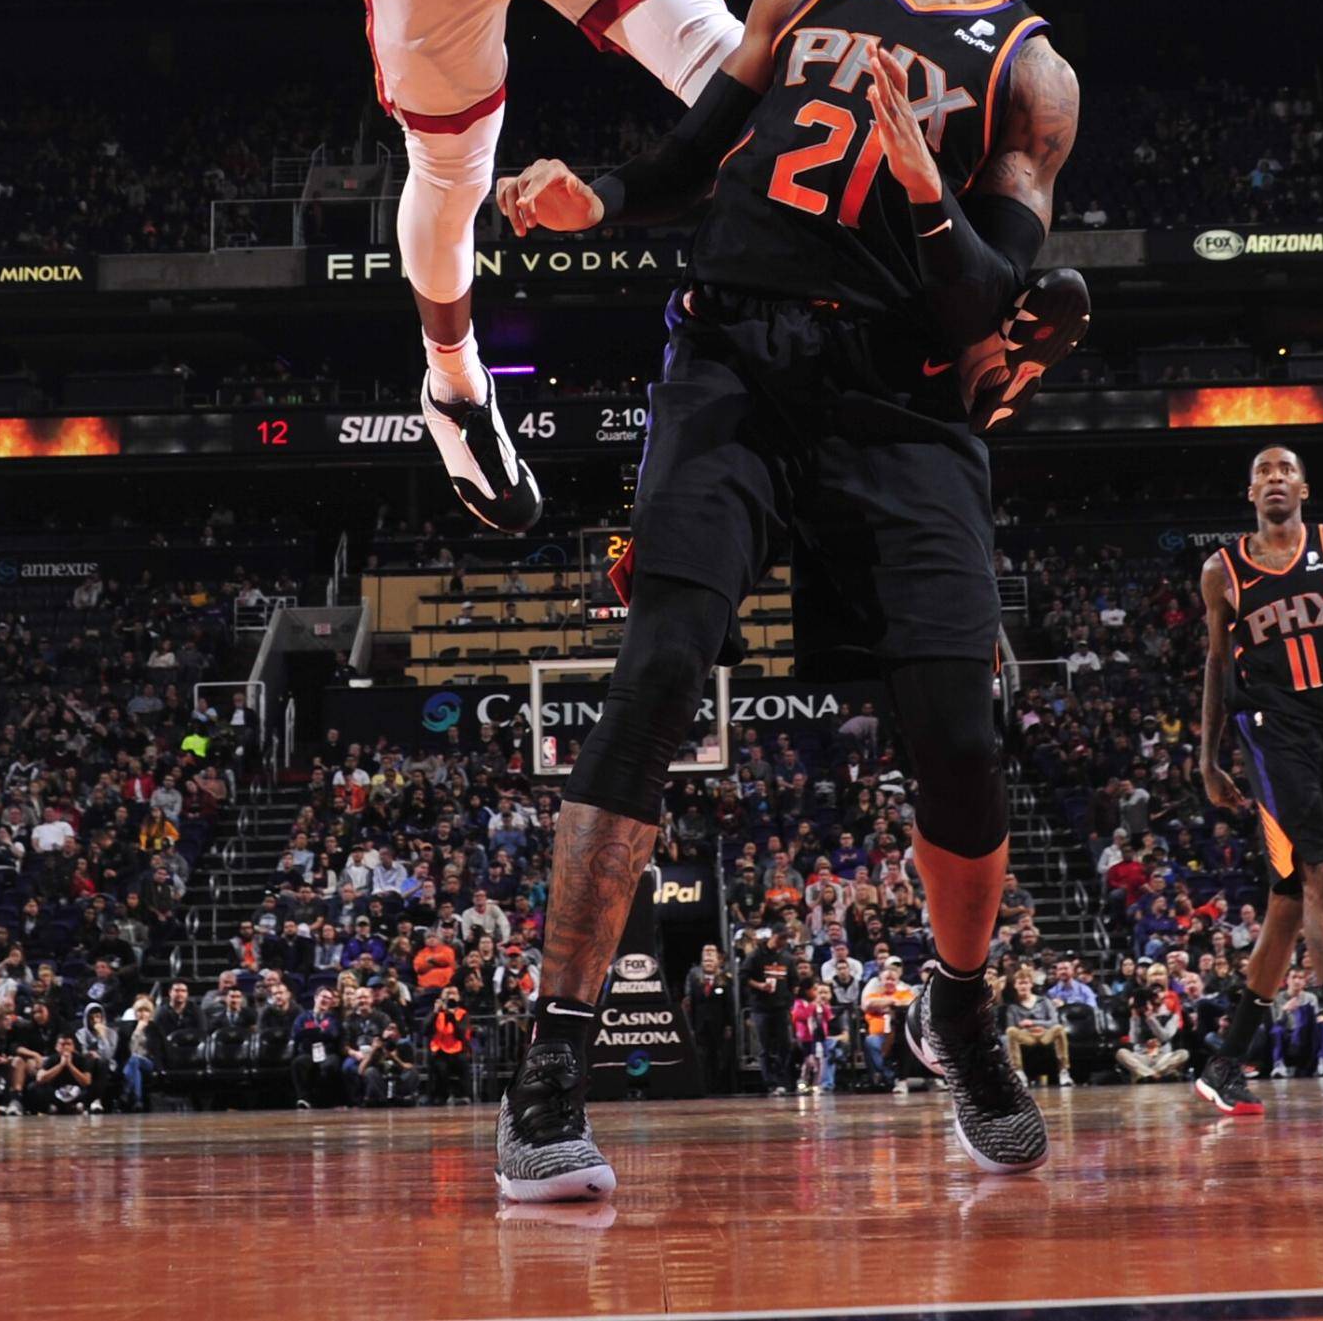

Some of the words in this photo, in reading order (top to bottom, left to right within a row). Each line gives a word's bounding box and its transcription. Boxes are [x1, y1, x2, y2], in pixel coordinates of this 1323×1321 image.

[953, 27, 996, 54] PayPal
[1205, 236, 1234, 249] FOX
[0, 265, 83, 283] MINOLTA
[327, 250, 502, 280] EFN
[521, 250, 658, 272] VODKA
[257, 420, 289, 445] 12
[518, 411, 557, 439] 45
[601, 407, 647, 428] 2:10
[595, 429, 639, 442] Quarter
[20, 561, 99, 578] annexus
[477, 693, 605, 728] CASIN
[624, 959, 648, 970] FOX
[610, 980, 663, 994] ARIZONA
[601, 1008, 673, 1027] CASINO
[594, 1028, 681, 1047] ARIZONA
